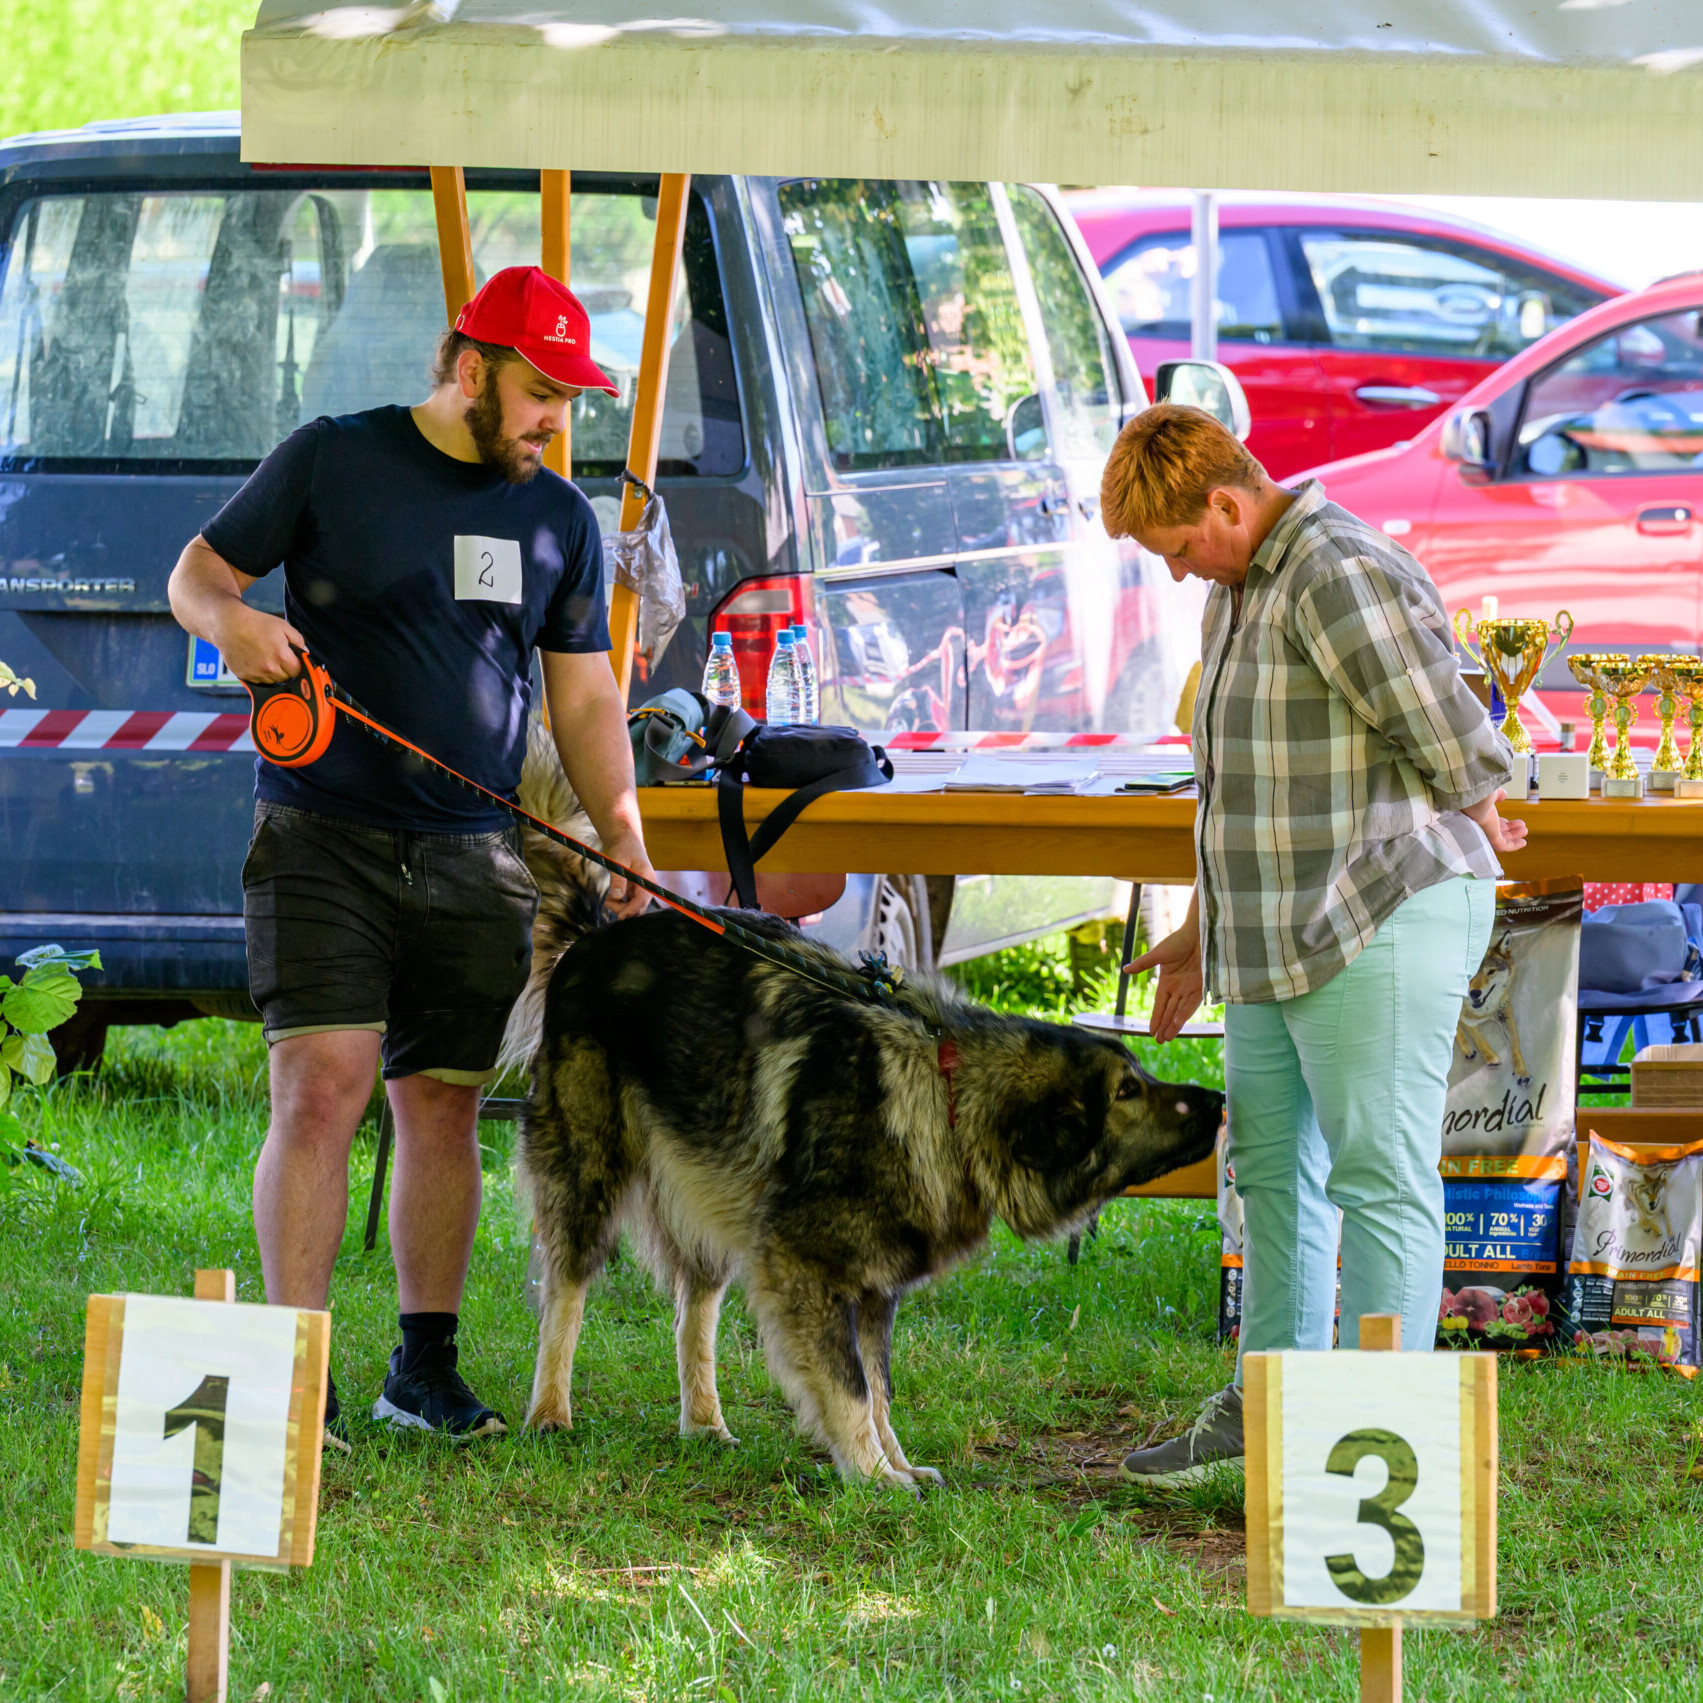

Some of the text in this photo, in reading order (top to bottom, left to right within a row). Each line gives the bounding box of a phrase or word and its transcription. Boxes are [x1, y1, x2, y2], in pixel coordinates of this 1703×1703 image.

[478, 551, 494, 588] 2
[196, 662, 216, 675] SLO
[1508, 904, 1549, 915] NUTRITION
[1468, 1159, 1519, 1174] FREE
[1484, 1187, 1554, 1203] Philosophy
[1490, 1212, 1518, 1226] 70%
[1483, 1245, 1516, 1259] ALL
[1593, 1229, 1682, 1263] Primordial
[1469, 1261, 1499, 1269] TONNO
[1639, 1270, 1666, 1280] FREE
[1613, 1307, 1645, 1317] ADULT
[1646, 1309, 1665, 1319] ALL
[163, 1375, 230, 1545] 1
[1325, 1428, 1425, 1605] 3
